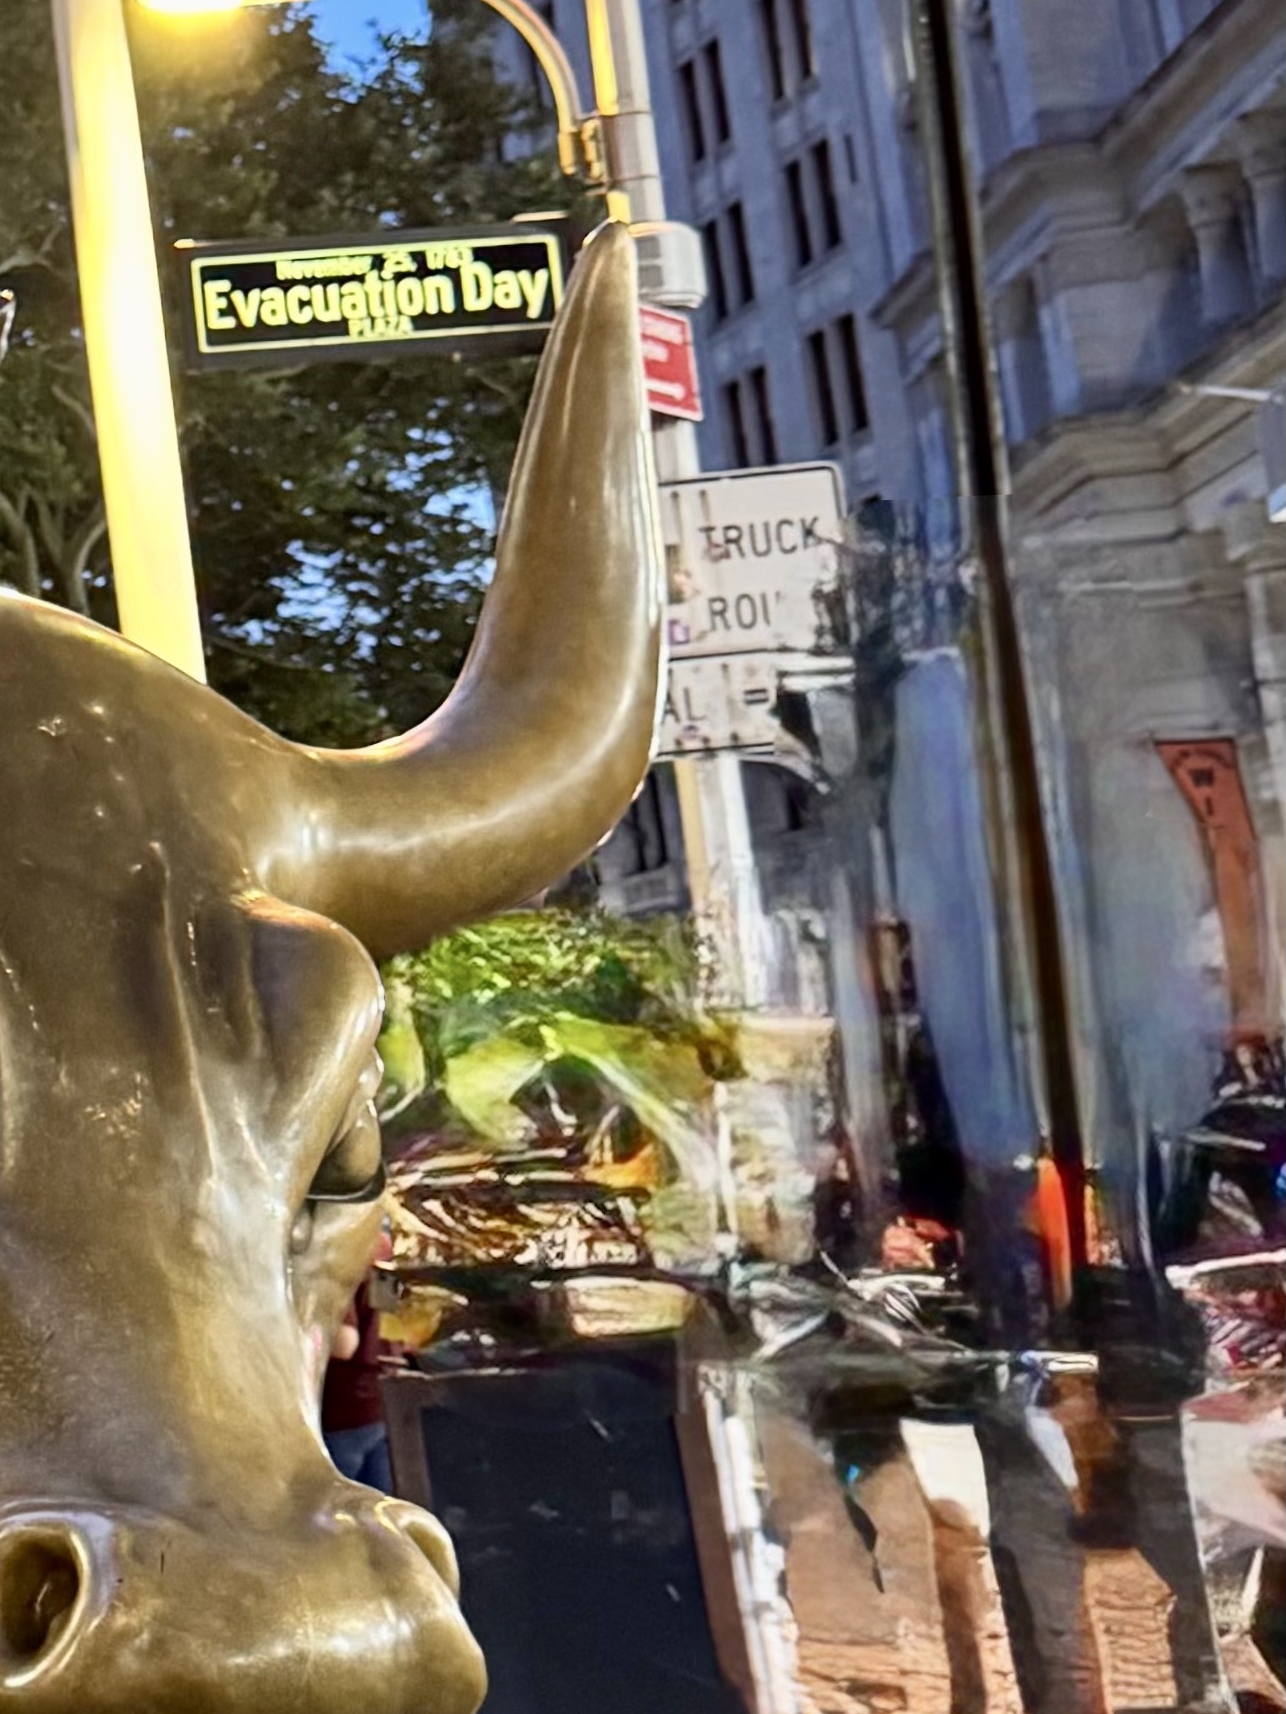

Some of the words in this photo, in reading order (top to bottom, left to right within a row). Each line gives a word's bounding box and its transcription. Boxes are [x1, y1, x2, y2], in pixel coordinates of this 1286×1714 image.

[203, 269, 456, 331] Evacuation
[459, 260, 550, 320] Day
[348, 315, 415, 338] PLAZA
[698, 516, 820, 559] TRUCK
